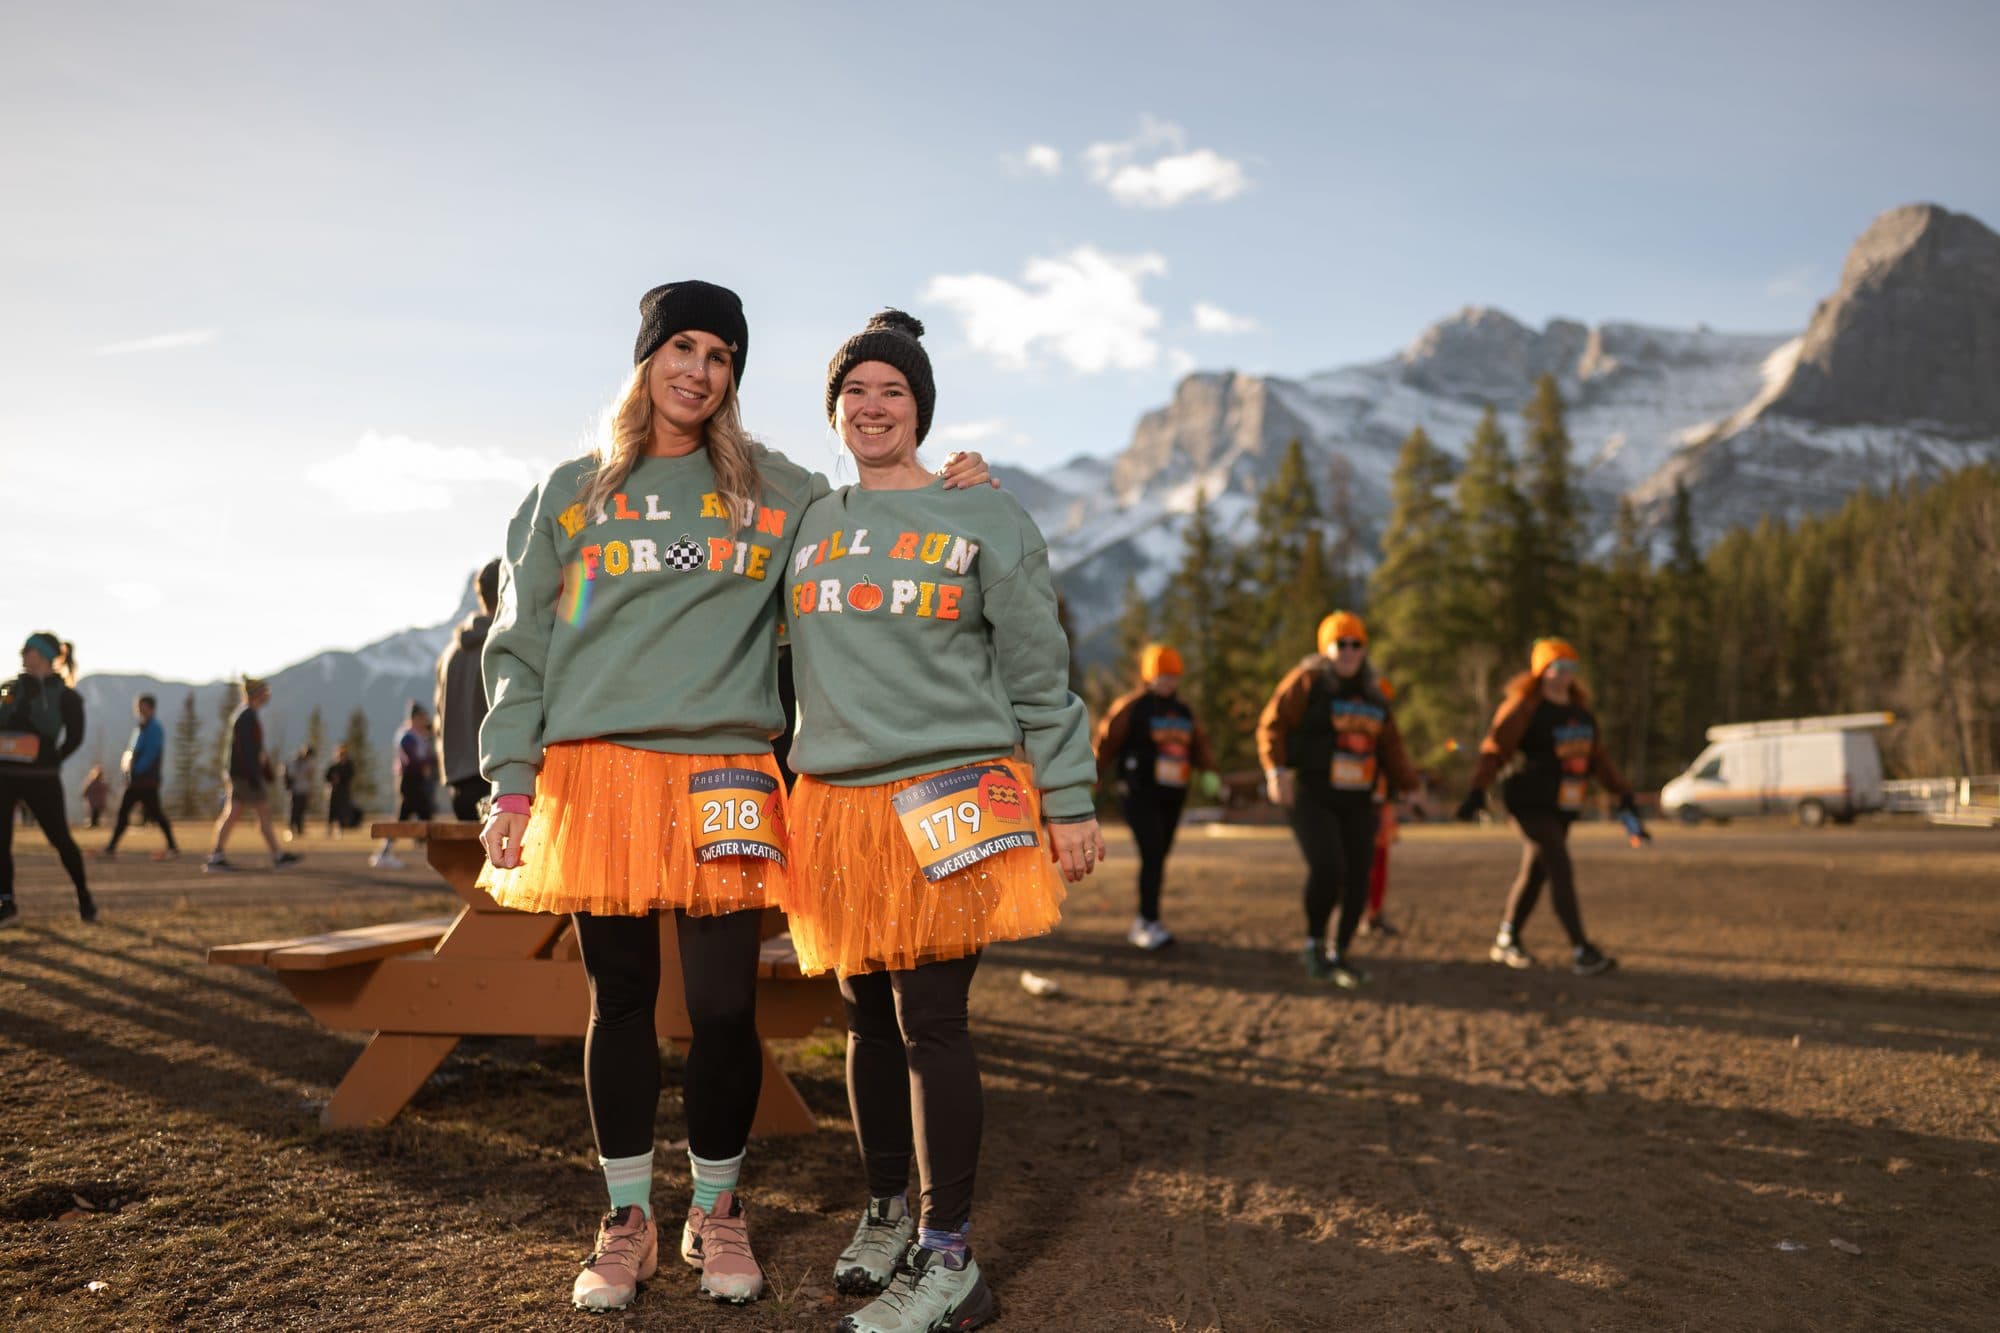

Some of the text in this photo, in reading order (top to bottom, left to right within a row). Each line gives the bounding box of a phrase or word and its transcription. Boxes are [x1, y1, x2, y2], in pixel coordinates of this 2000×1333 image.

[581, 536, 771, 581] FOR PIE
[794, 528, 979, 577] WILL RUN
[792, 578, 963, 620] FOR PIE
[701, 797, 761, 834] 218
[918, 800, 983, 851] 179
[701, 842, 740, 863] SWEATER
[740, 841, 783, 865] WEATHER
[932, 849, 980, 880] SWEATER
[977, 835, 1022, 858] WEATHER
